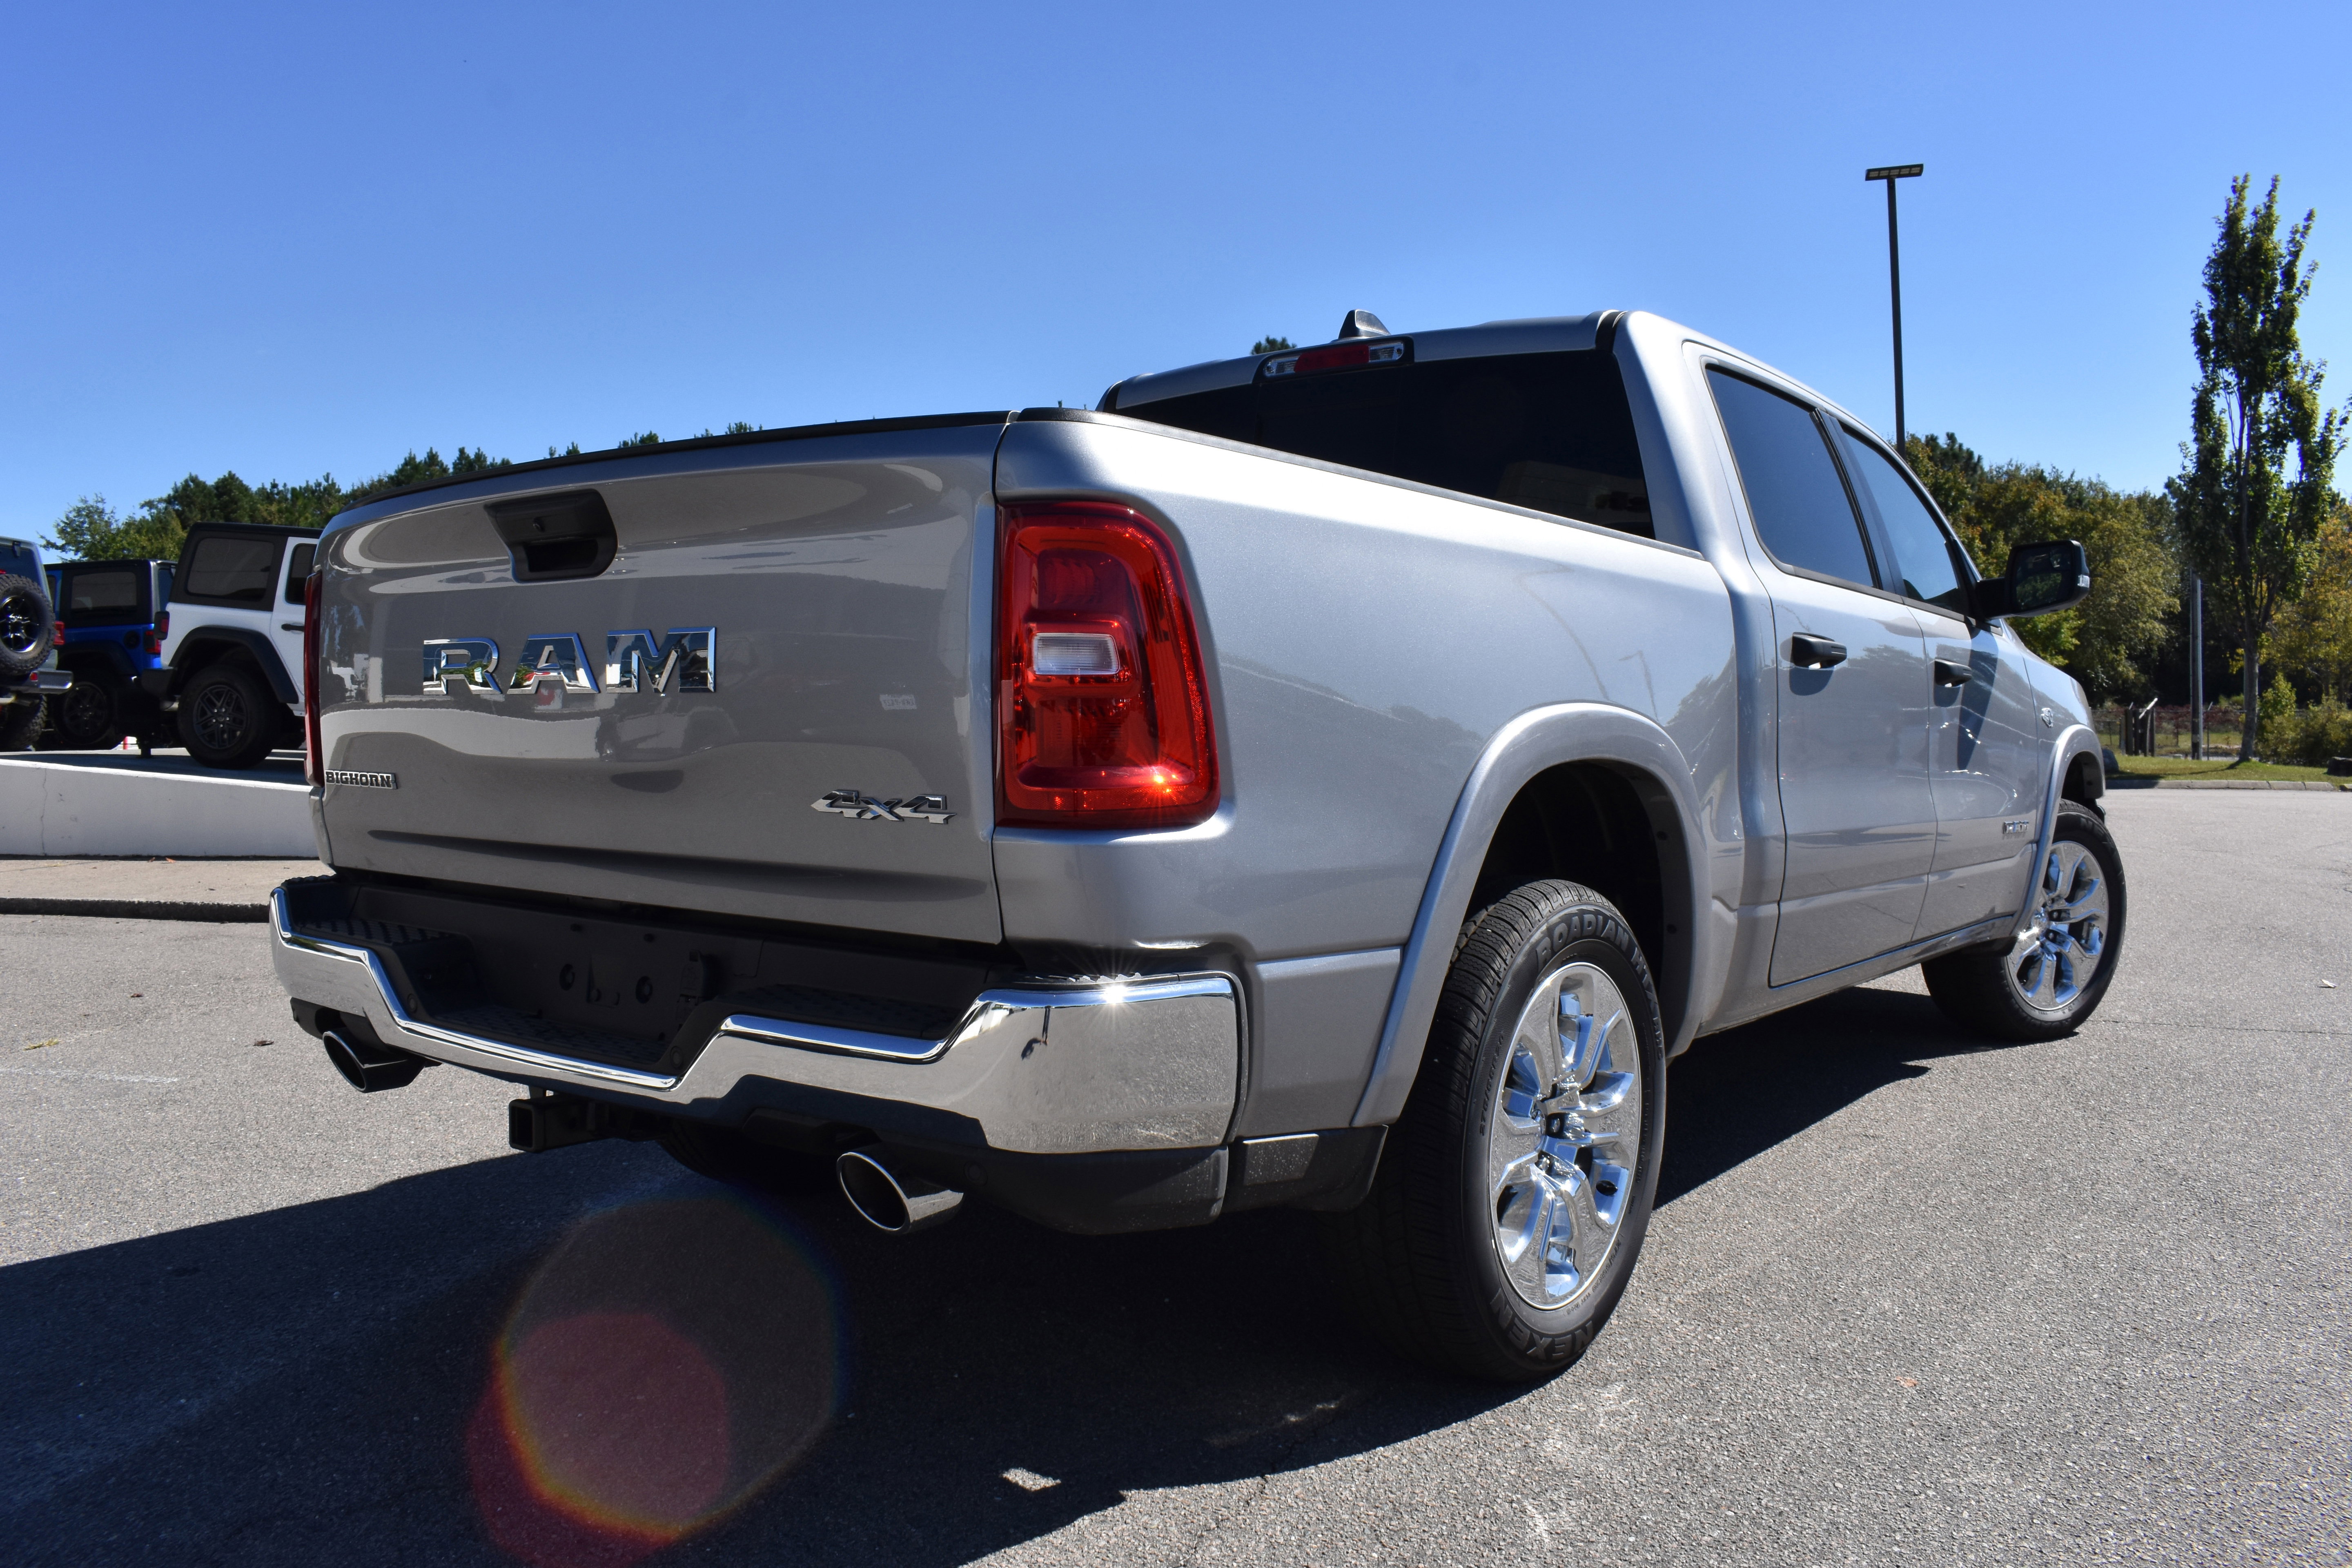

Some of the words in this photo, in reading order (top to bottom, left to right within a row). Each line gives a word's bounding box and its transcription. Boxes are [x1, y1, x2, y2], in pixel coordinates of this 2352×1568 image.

[423, 626, 717, 696] RAM
[325, 770, 397, 789] BIGHORN
[1536, 914, 1629, 972] ROADIAN
[1630, 947, 1659, 1015] HTX
[1490, 1288, 1594, 1360] NEXEN
